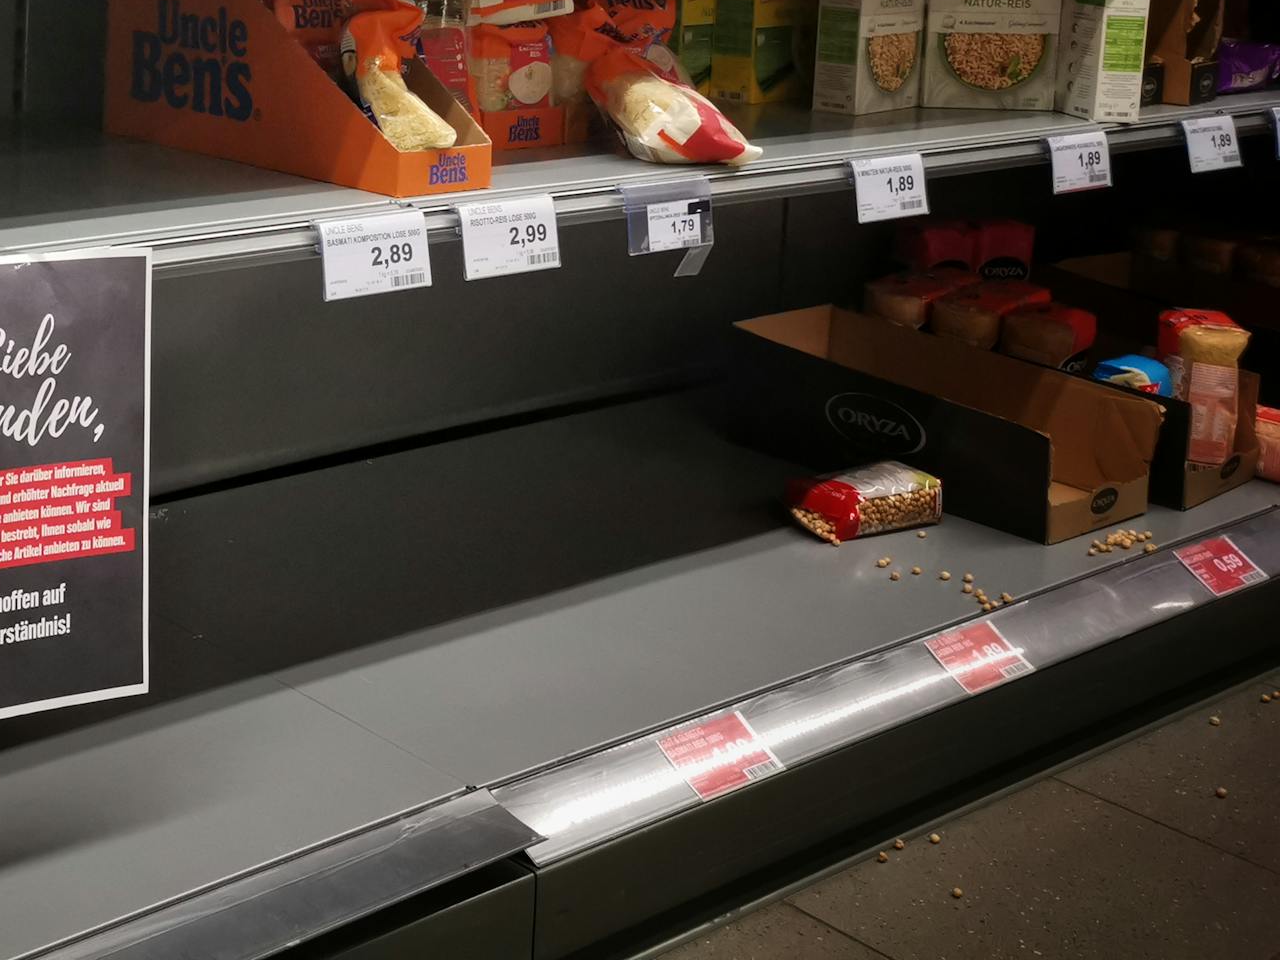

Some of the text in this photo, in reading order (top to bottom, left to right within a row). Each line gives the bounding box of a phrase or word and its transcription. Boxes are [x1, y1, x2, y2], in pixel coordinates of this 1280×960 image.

[1210, 132, 1232, 150] 1,89
[438, 153, 467, 171] Uncle
[1078, 152, 1102, 170] 1,89
[886, 176, 914, 195] 1,89
[509, 224, 547, 248] 2,99
[670, 218, 695, 234] 1,79
[370, 243, 412, 269] 2,89
[836, 406, 913, 440] ORYZA
[6, 472, 18, 486] Sie
[20, 468, 52, 484] darüber
[54, 464, 106, 480] informieren,
[12, 486, 49, 502] erhöhter
[50, 482, 94, 500] Nachfrage
[96, 478, 124, 492] aktuell
[3, 508, 40, 523] anbieten
[40, 504, 74, 519] können.
[76, 499, 90, 514] Wir
[92, 498, 110, 512] sind
[1, 526, 40, 542] bestrebt,
[41, 522, 66, 538] Ihnen
[66, 519, 95, 534] sobald
[96, 517, 112, 530] wie
[14, 546, 42, 560] Artikel
[43, 540, 80, 556] anbieten
[81, 538, 91, 551] zu
[92, 534, 126, 548] können.
[1216, 552, 1244, 574] 0,59
[42, 582, 67, 606] auf
